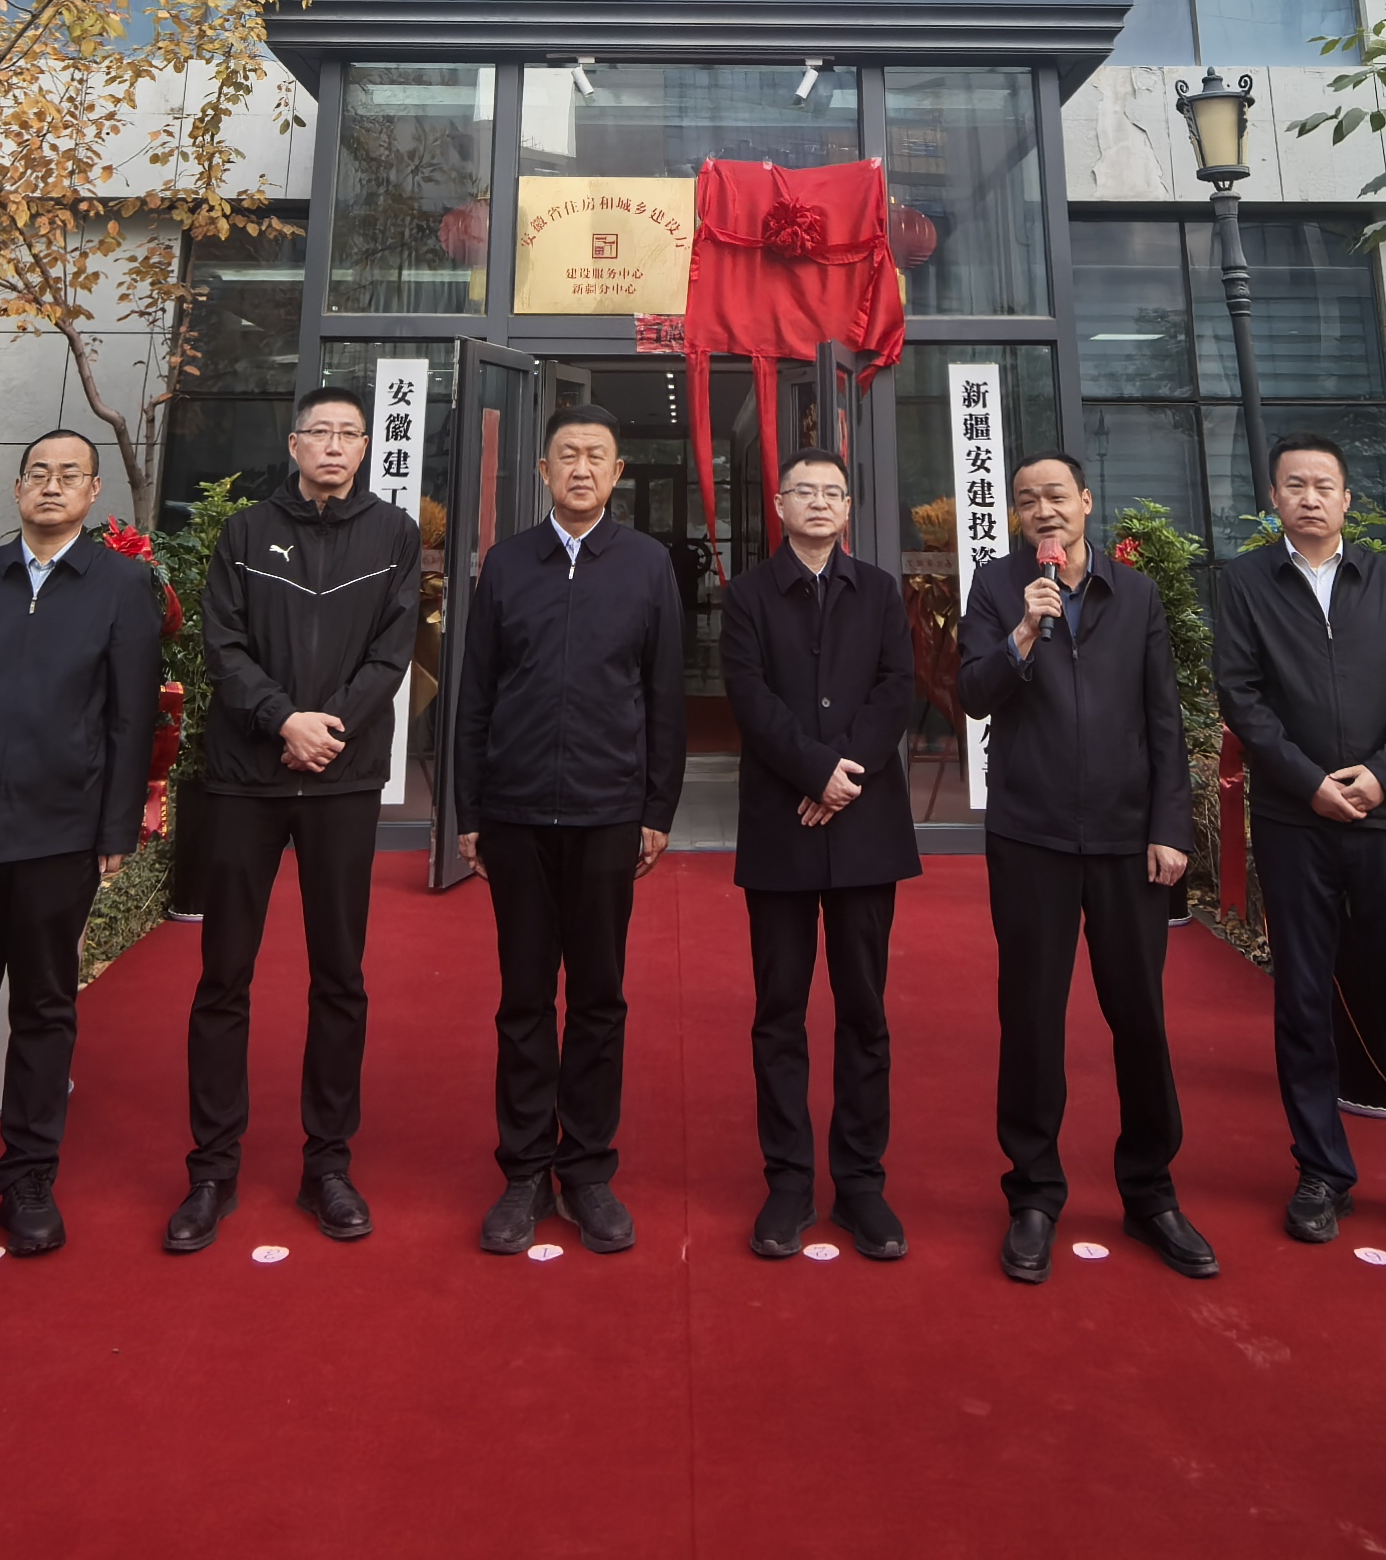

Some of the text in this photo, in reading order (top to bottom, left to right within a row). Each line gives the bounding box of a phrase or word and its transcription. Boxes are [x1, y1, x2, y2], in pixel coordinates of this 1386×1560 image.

[566, 267, 644, 280] 建设服务中心
[572, 283, 636, 295] 新疆分中心
